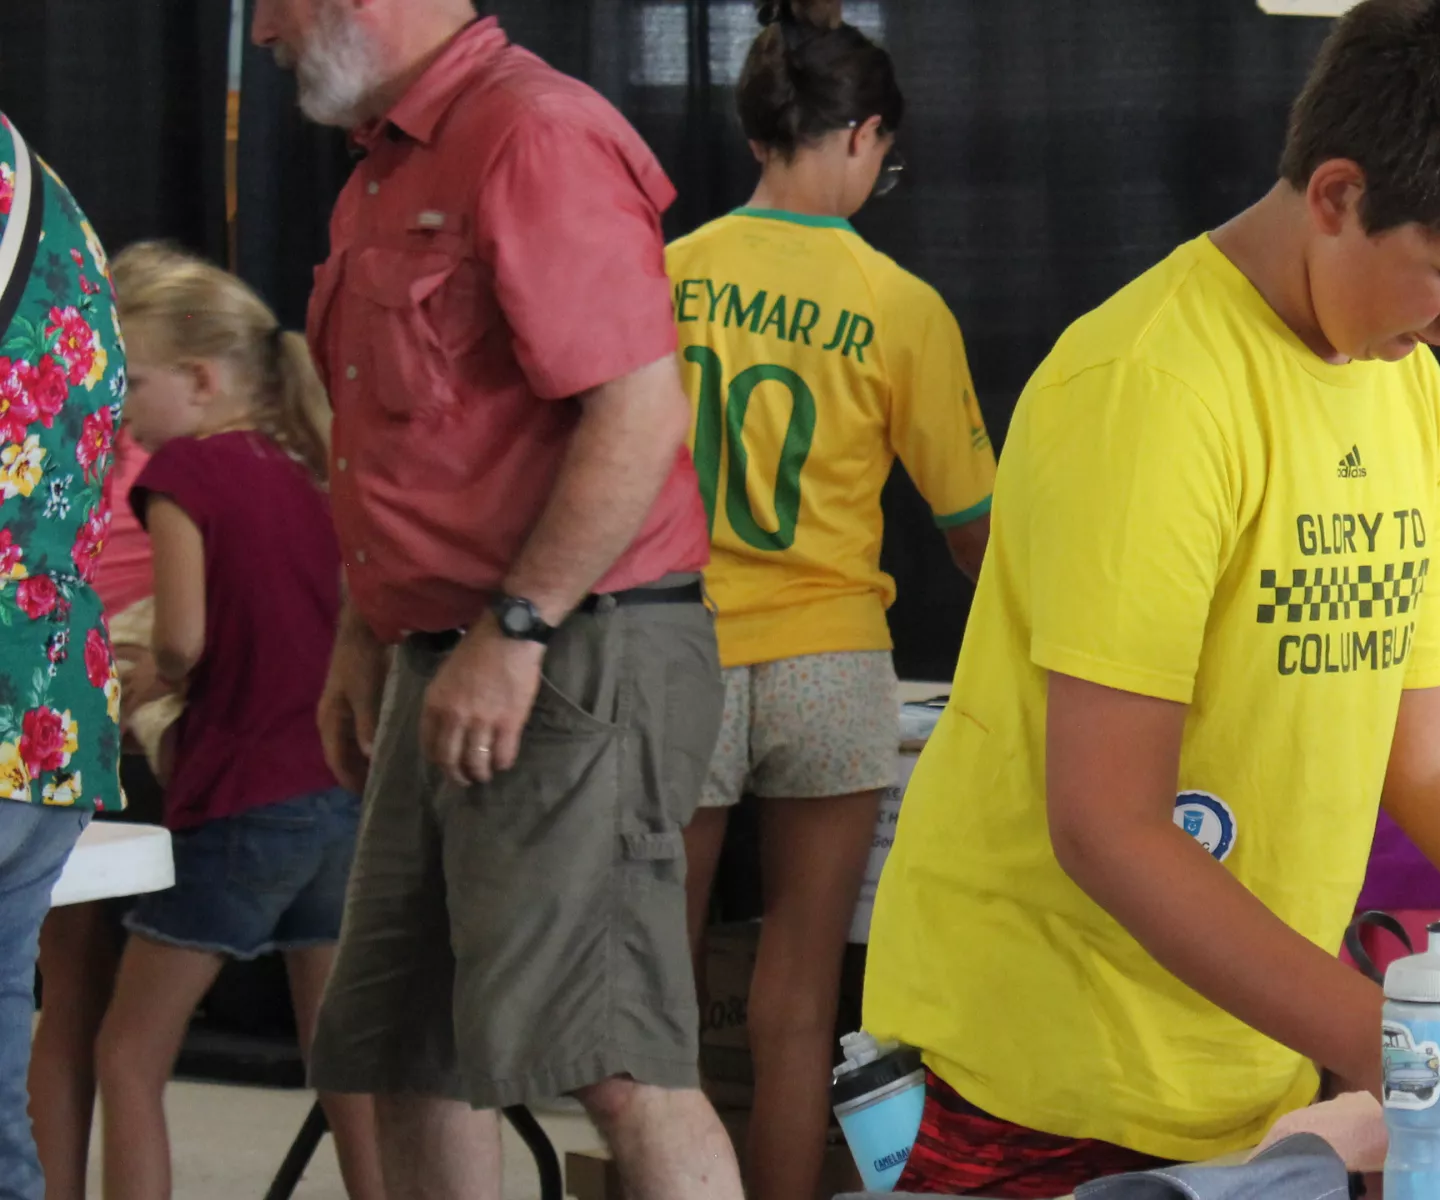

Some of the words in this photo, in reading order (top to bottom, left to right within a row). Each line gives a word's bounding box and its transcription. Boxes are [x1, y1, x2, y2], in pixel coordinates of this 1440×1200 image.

[822, 309, 875, 364] JR
[683, 345, 817, 552] 10
[1337, 465, 1367, 479] adidas
[1296, 511, 1384, 557] GLORY
[1393, 508, 1427, 550] TO
